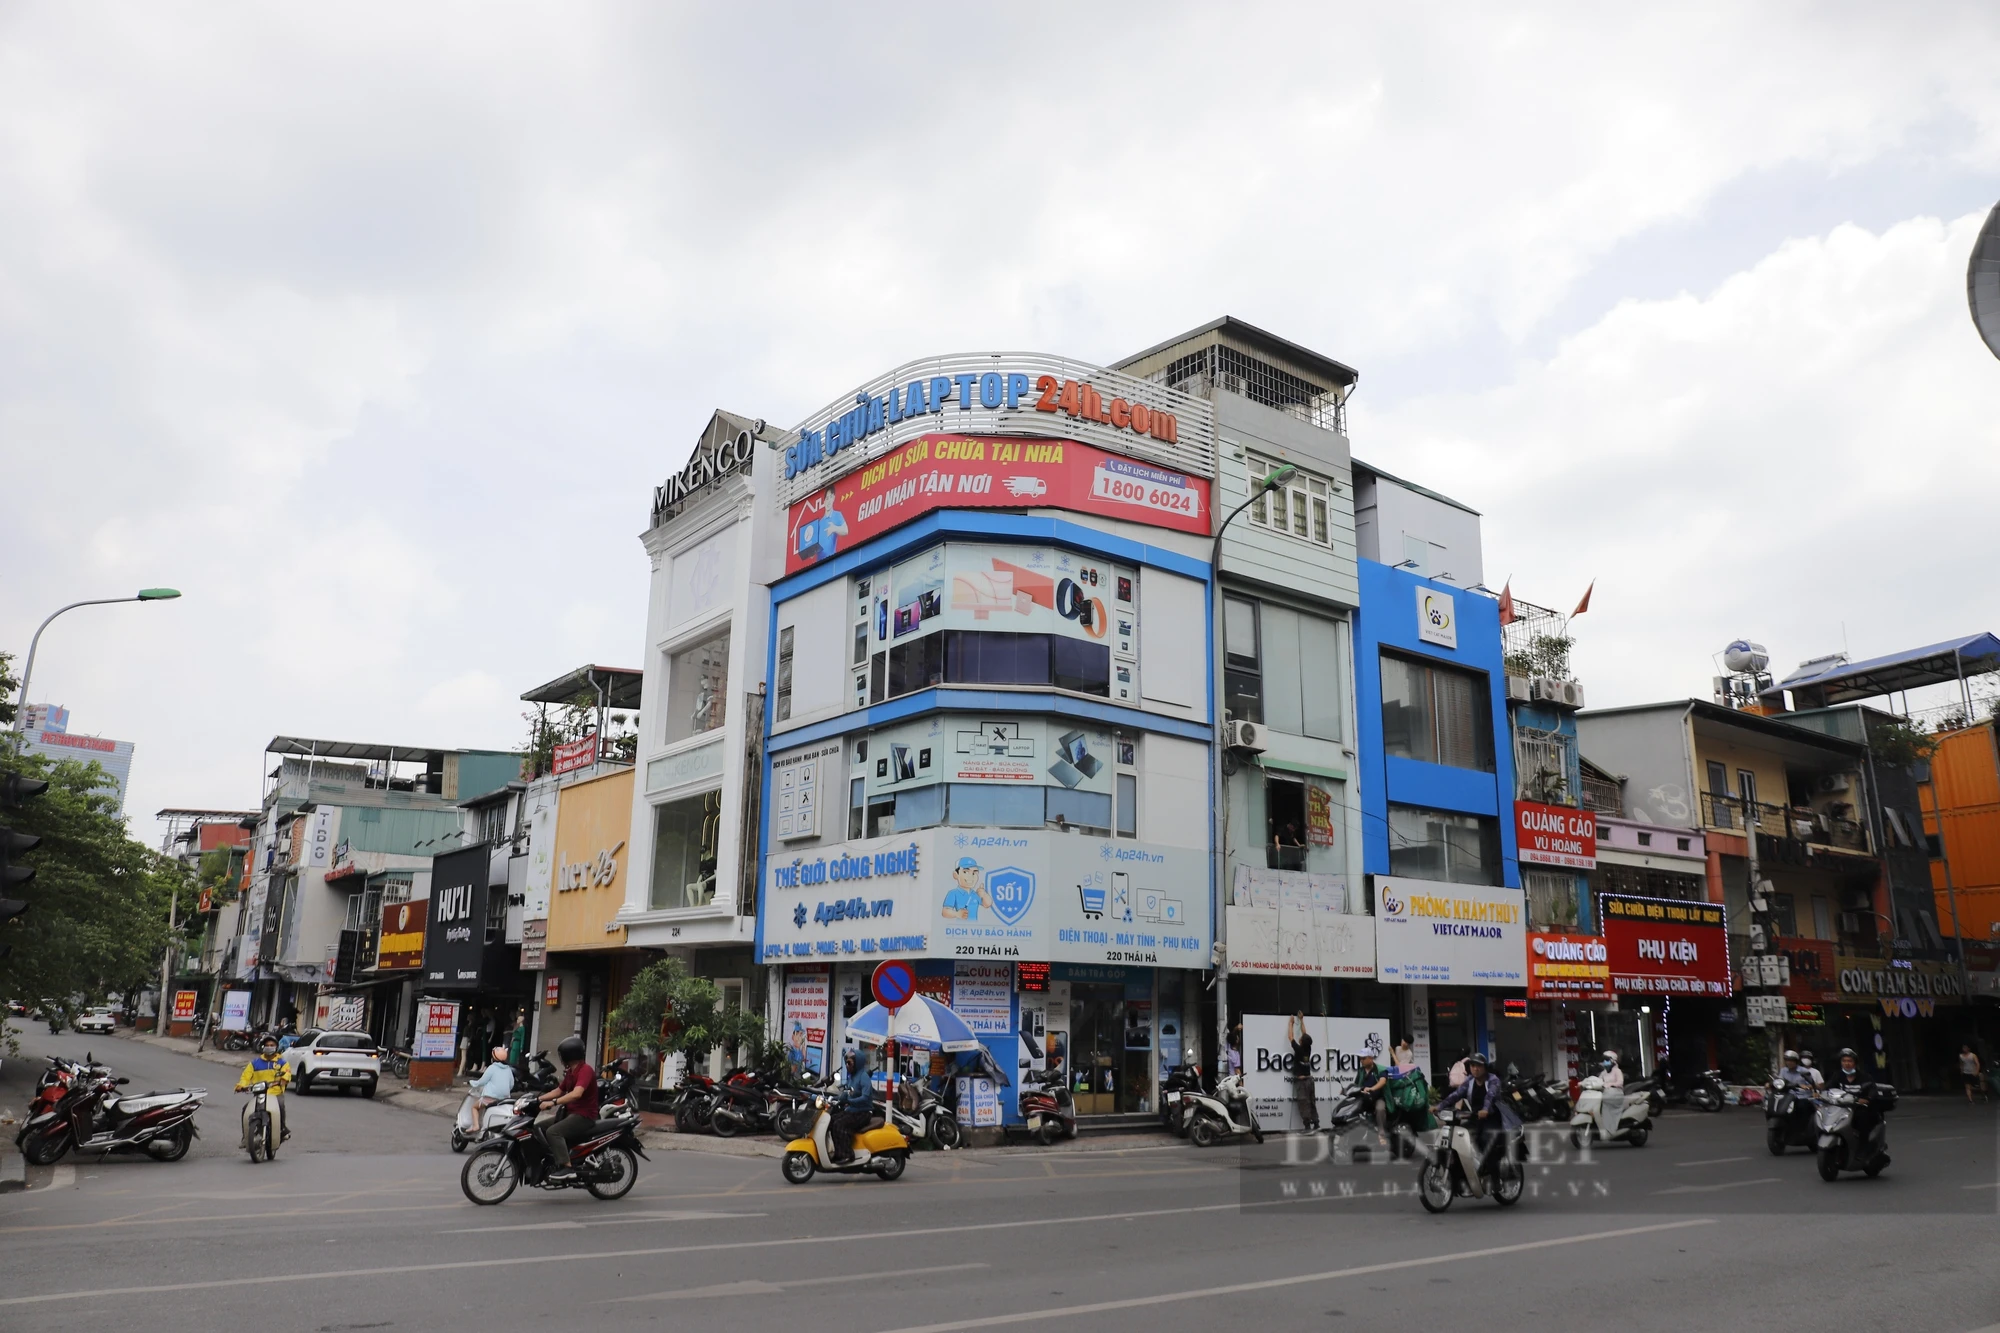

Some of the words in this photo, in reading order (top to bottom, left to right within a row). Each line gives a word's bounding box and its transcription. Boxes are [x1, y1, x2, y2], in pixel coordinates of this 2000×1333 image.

[784, 427, 824, 480] SỬA
[825, 389, 886, 457] CHỮA
[886, 372, 1029, 425] LAPTOP
[1036, 374, 1178, 444] 24h.com
[652, 435, 753, 516] MIKENCO
[861, 464, 886, 492] DỊCH
[888, 450, 905, 477] VỤ
[905, 438, 929, 468] SỬA
[934, 439, 984, 461] CHỮA
[992, 443, 1020, 466] TẠI
[1025, 442, 1064, 464] NHÀ
[1117, 463, 1131, 475] ĐẶT
[1133, 467, 1150, 479] LỊCH
[1151, 471, 1168, 482] MIỄN
[1169, 475, 1182, 485] PHÍ
[858, 494, 881, 522] GIAO
[884, 476, 918, 510] NHẬN
[920, 469, 953, 496] TẬN
[957, 473, 993, 494] NƠI
[1103, 477, 1145, 502] 1800
[1149, 489, 1190, 512] 6024
[41, 731, 116, 753] PETROVIETNAM
[1521, 807, 1565, 835] QUẢNG
[1568, 814, 1594, 839] CÁO
[970, 836, 1029, 849] Ap24h.vn
[1533, 834, 1549, 851] VŨ
[1551, 836, 1583, 855] HOÀNG
[775, 858, 801, 888] THẾ
[801, 857, 828, 886] GIỚI
[830, 851, 873, 882] CÔNG
[873, 842, 920, 878] NGHỆ
[1114, 847, 1165, 864] Ap24h.vn
[996, 881, 1014, 902] SỐ
[1016, 886, 1023, 901] 1
[813, 896, 894, 928] Ap24h.vn
[1409, 891, 1450, 919] PHÒNG
[1453, 896, 1489, 922] KHÁM
[1511, 904, 1520, 924] Y
[1608, 898, 1625, 915] SỬA
[1625, 901, 1646, 917] CHỮA
[1646, 904, 1665, 920] ĐIỆN
[1666, 906, 1688, 922] THOẠI
[1689, 905, 1701, 921] LẤY
[1703, 910, 1721, 923] NGAY
[945, 927, 968, 938] DỊCH
[971, 928, 984, 938] VỤ
[985, 927, 1005, 938] BẢO
[1006, 927, 1033, 938] HÀNH
[1058, 926, 1081, 944] ĐIỆN
[1082, 929, 1108, 946] THOẠI
[1115, 931, 1135, 947] MÁY
[1136, 932, 1156, 948] TÍNH
[1162, 935, 1179, 951] PHỤ
[1180, 934, 1200, 952] KIỆN
[880, 935, 927, 953] SMARTPHONE
[956, 945, 975, 956] 220
[977, 944, 1001, 956] THÁI
[1003, 944, 1020, 956] HÀ
[1545, 937, 1584, 962] QUẢNG
[1585, 938, 1608, 963] CÁO
[1637, 938, 1666, 965] PHỤ
[1668, 937, 1699, 966] KIỆN
[1106, 950, 1121, 962] 220
[1123, 950, 1144, 963] THÁI
[1145, 950, 1158, 964] HÀ
[955, 978, 977, 987] LAPTOP
[980, 979, 1010, 987] MACBOOK
[969, 965, 992, 978] CỨU
[993, 965, 1010, 981] HỘ
[969, 987, 1006, 998] Ap24h.vn
[1613, 976, 1630, 992] PHỤ
[1630, 976, 1648, 992] KIỆN
[1654, 976, 1670, 992] SỬA
[1670, 978, 1689, 992] CHỮA
[1689, 979, 1706, 994] ĐIỆN
[1879, 998, 1936, 1018] WOW
[974, 1019, 992, 1030] THÁI
[994, 1019, 1007, 1031] HÀ
